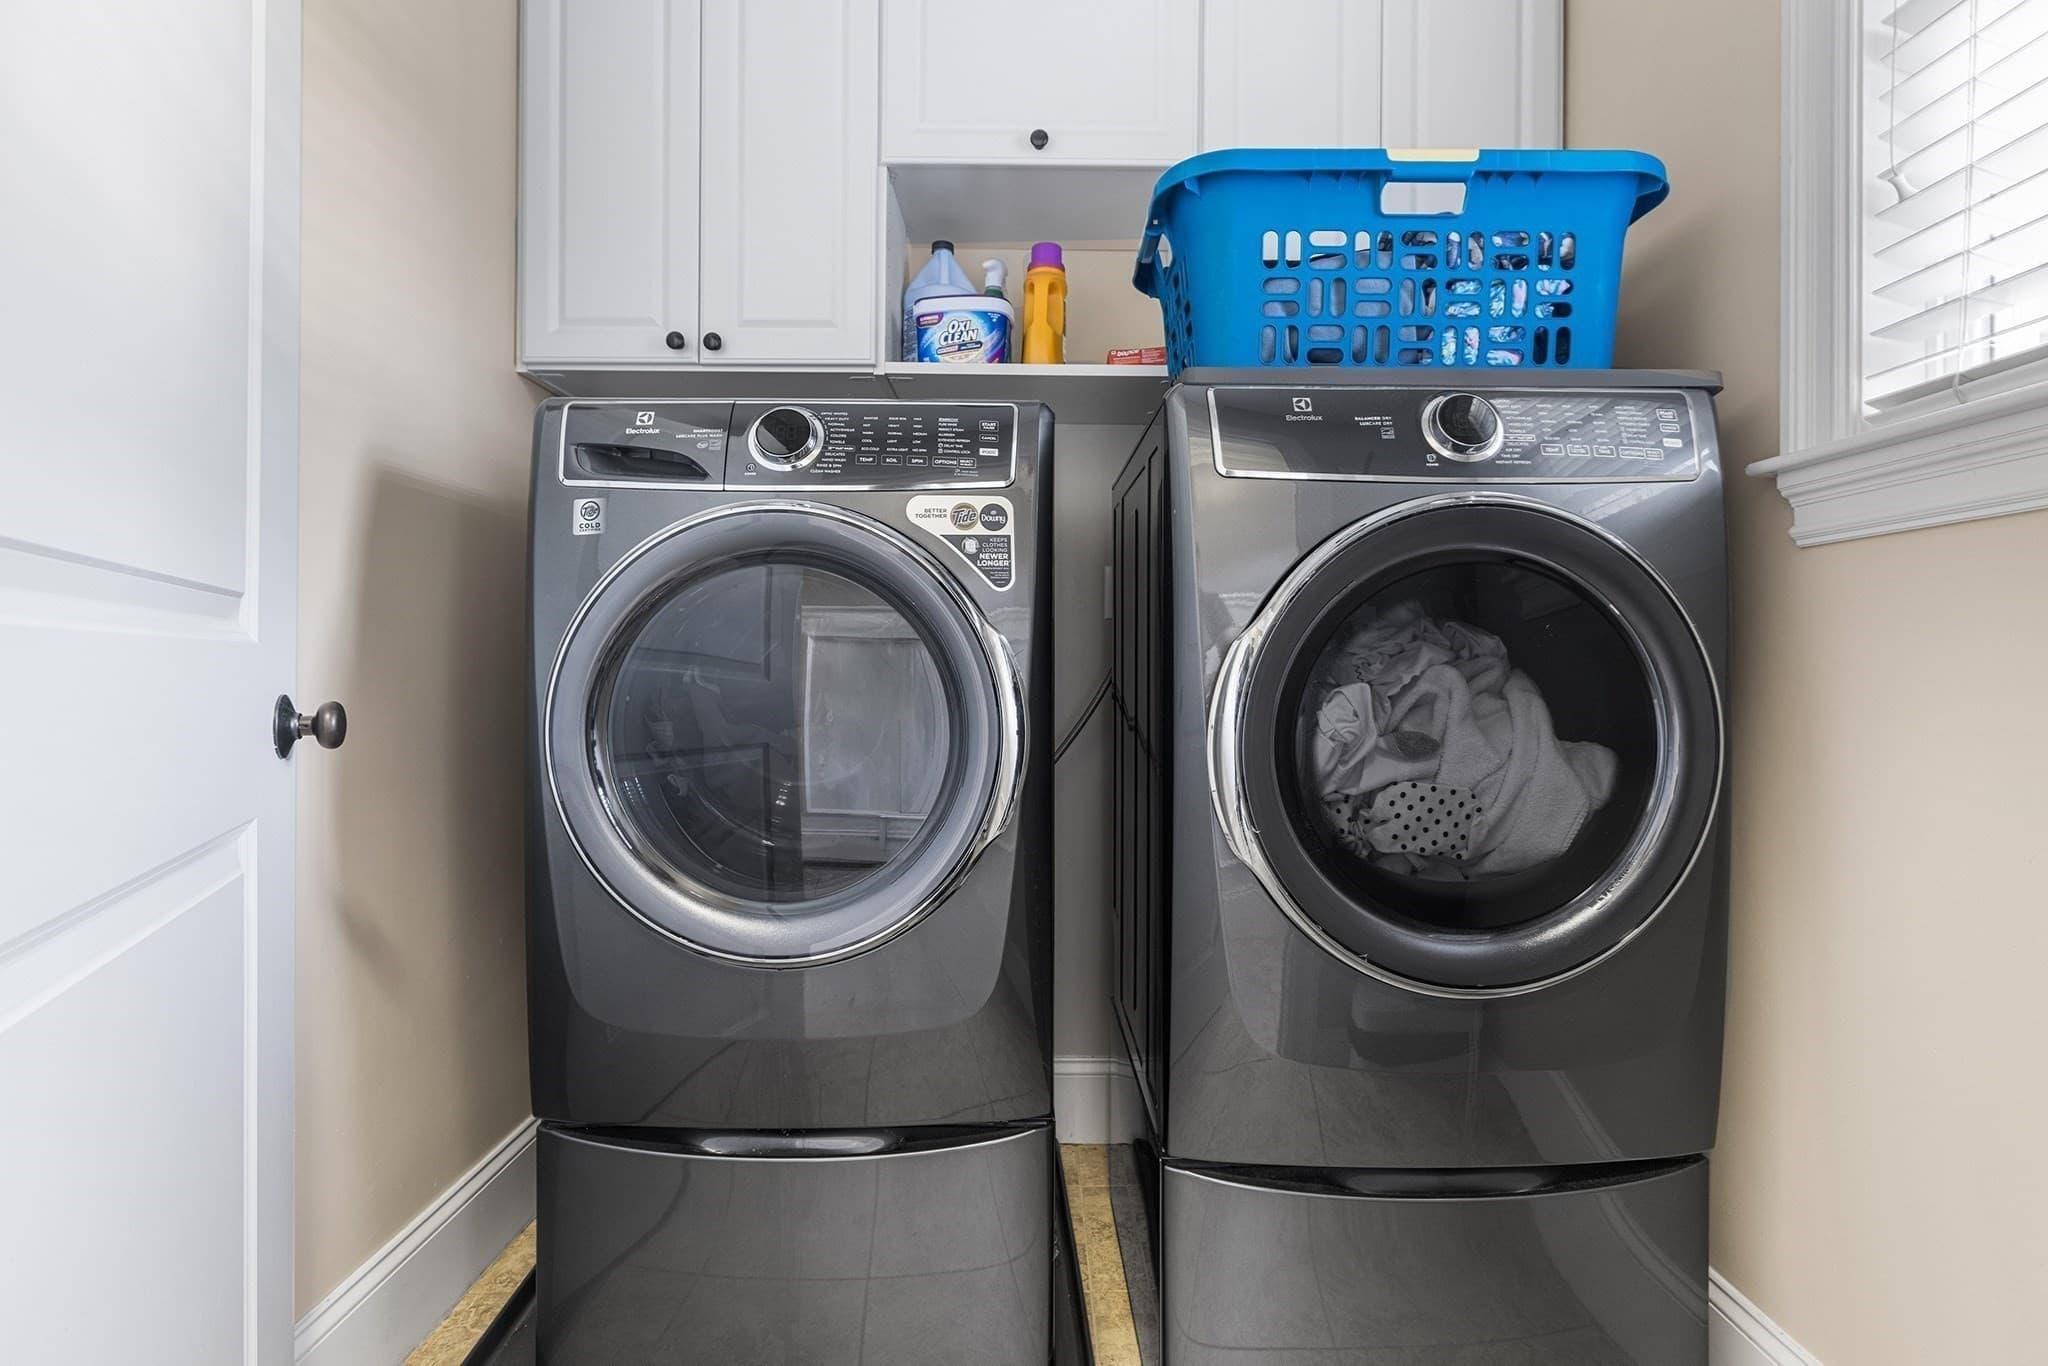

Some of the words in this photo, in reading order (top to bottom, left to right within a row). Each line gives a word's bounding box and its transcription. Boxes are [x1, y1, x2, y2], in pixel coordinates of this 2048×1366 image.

[948, 319, 971, 334] OXI
[939, 328, 979, 346] CLEAN
[953, 509, 977, 526] Tide
[981, 514, 1006, 523] Downy
